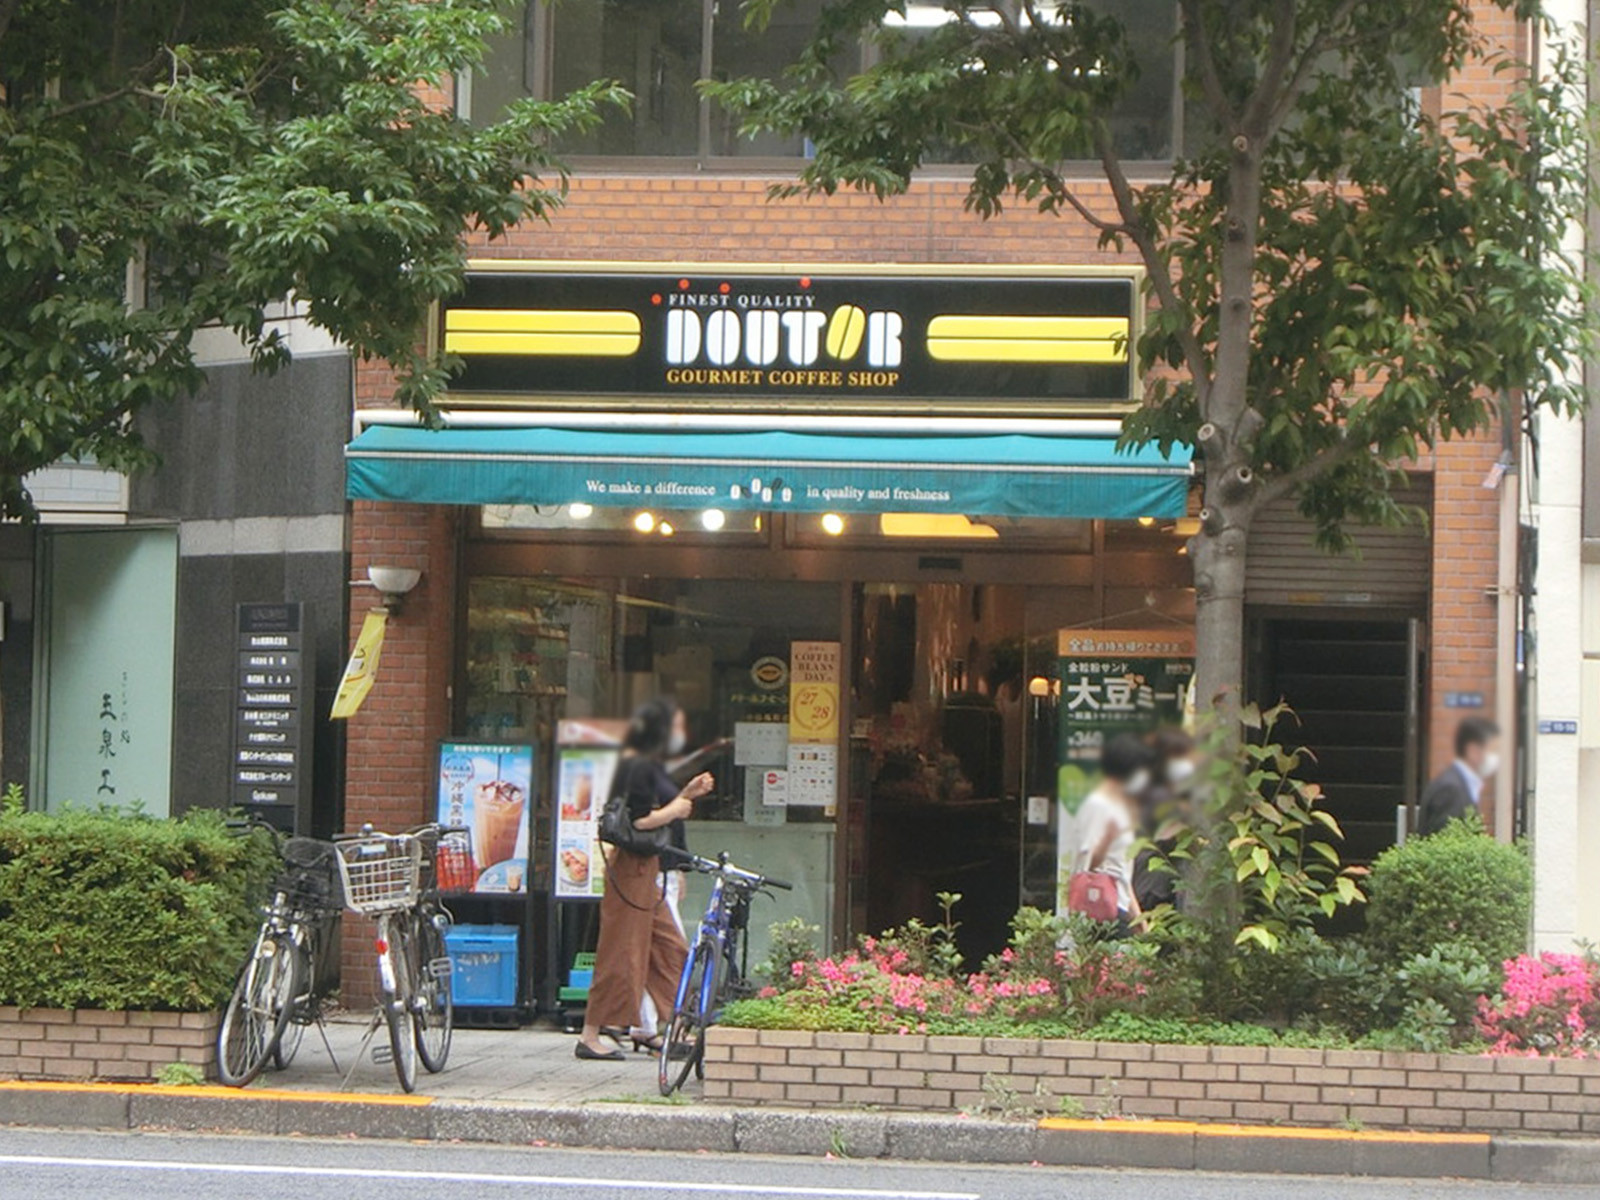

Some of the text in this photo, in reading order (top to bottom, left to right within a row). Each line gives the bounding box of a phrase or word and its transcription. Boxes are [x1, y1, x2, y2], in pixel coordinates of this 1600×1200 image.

[668, 294, 816, 308] FINEST QUALITY
[666, 304, 903, 367] DOUTOR
[666, 369, 900, 387] GOURMET COFFEE SHOP
[586, 480, 716, 495] We make a difference
[806, 485, 950, 502] in quality and freshness
